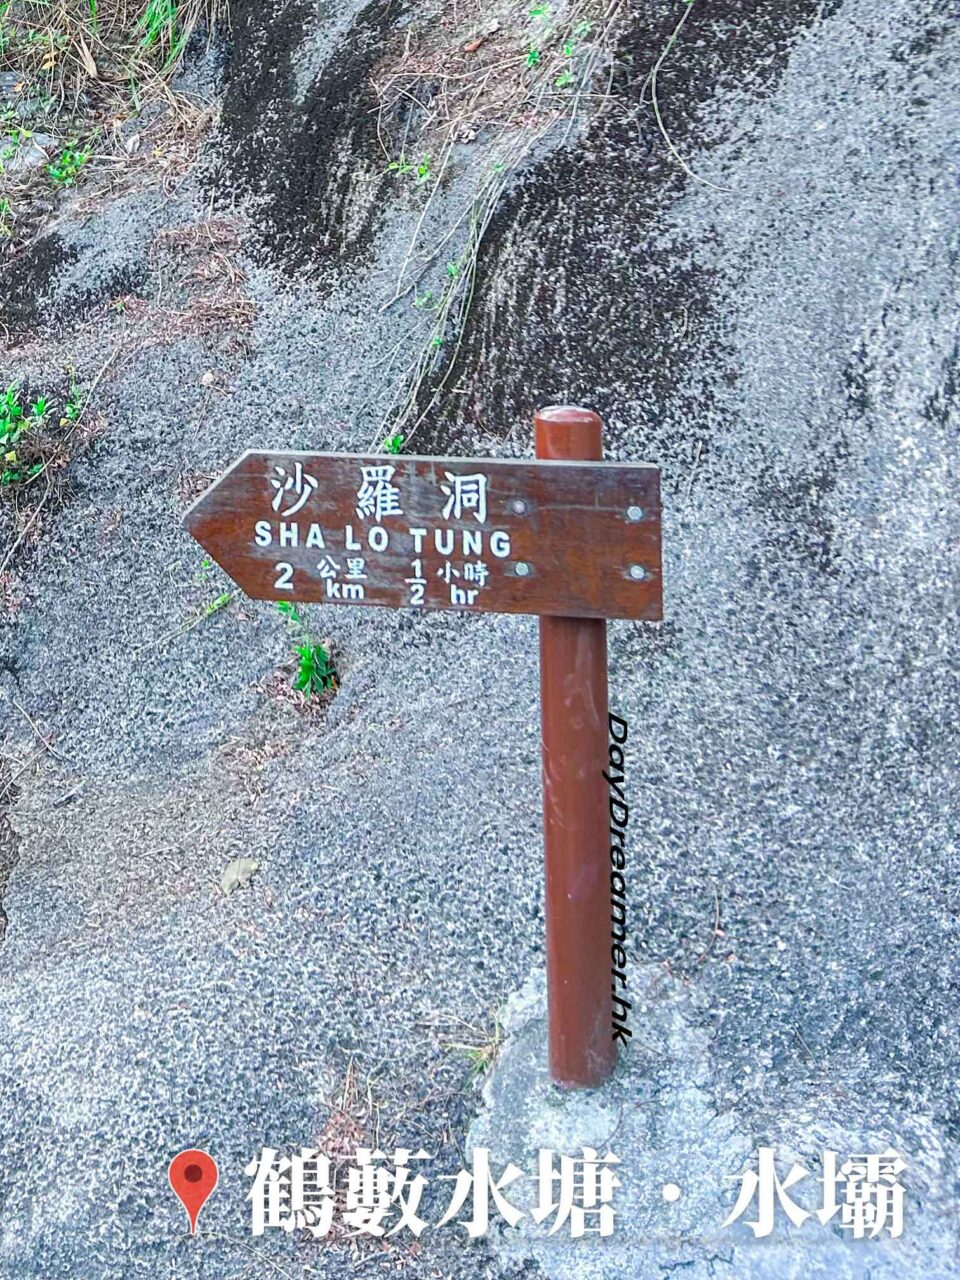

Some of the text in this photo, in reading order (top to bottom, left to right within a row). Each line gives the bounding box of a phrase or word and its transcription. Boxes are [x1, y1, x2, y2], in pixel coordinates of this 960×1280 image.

[270, 462, 487, 524] 沙羅洞
[255, 521, 511, 558] SHA LO TUNG
[273, 562, 294, 590] 2
[316, 557, 369, 580] 公里
[437, 561, 490, 588] 小時
[326, 580, 479, 606] km hr
